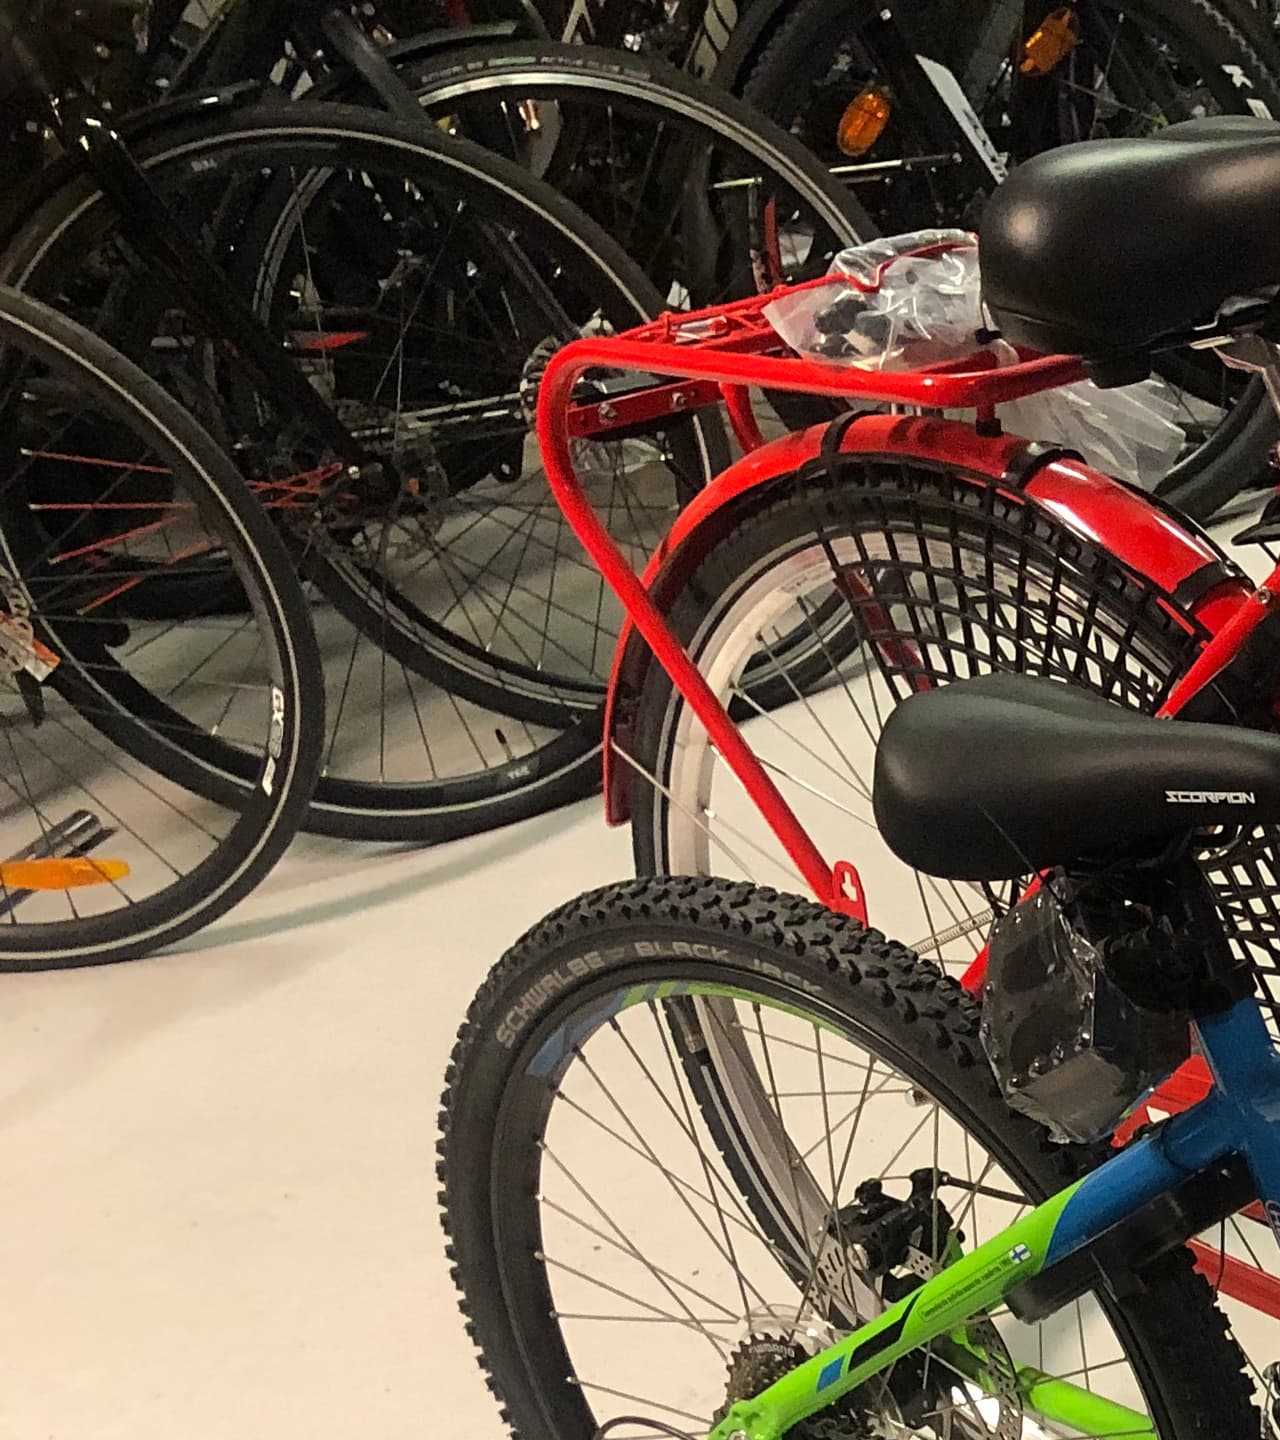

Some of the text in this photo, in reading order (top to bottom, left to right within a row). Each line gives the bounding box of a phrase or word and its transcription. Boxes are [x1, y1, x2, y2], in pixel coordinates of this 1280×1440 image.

[1165, 790, 1256, 805] SCORPION
[495, 940, 823, 1049] SCHWALBE BLACK JACK
